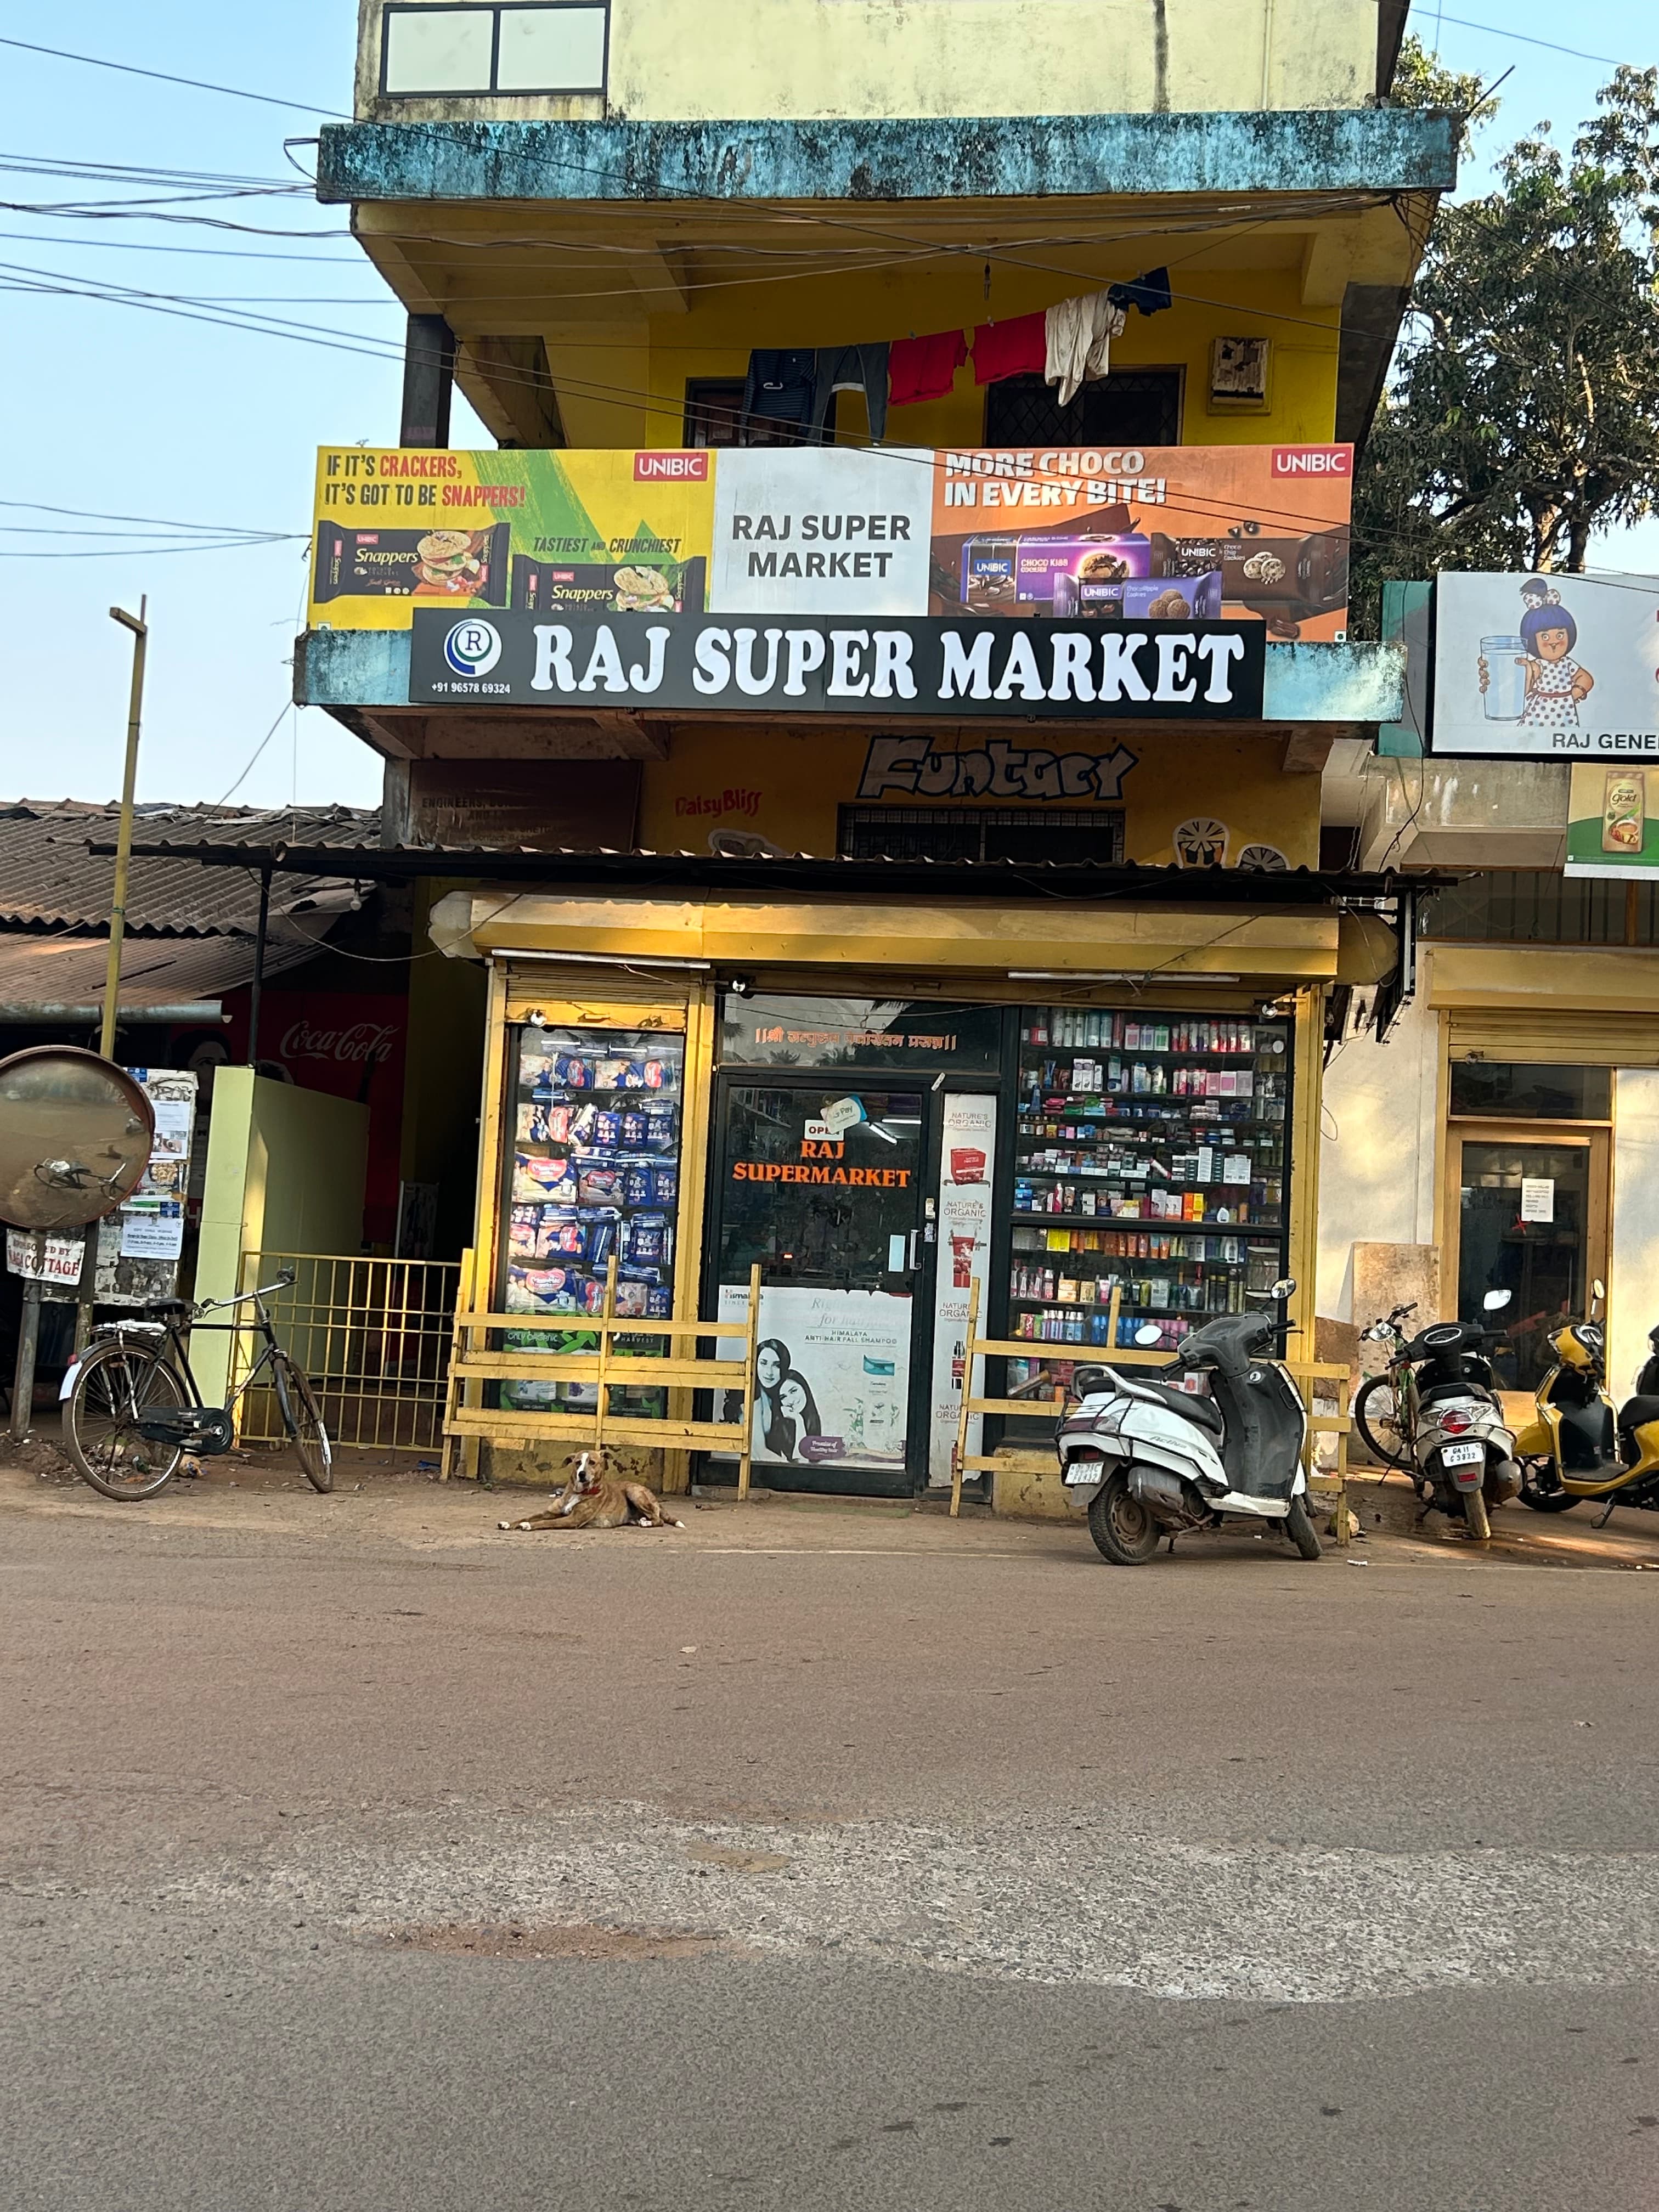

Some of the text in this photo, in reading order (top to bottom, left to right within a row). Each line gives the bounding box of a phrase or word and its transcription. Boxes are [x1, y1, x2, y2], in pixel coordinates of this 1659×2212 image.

[327, 455, 462, 479] IF IT'S CRACKERS,
[639, 458, 702, 476] UNIBIC
[945, 451, 1144, 477] MORE CHOCO
[1277, 453, 1346, 472] UNIBIC
[325, 483, 526, 507] IT'S GOT TO BE SNAPPERS!
[944, 478, 1166, 506] IN EVERY BITE!
[732, 515, 911, 540] RAJ SUPER
[533, 537, 589, 552] TASTIEST
[610, 538, 681, 554] CRUNCHIEST
[1181, 548, 1216, 557] UNIBIC
[355, 548, 419, 566] Snappers
[748, 552, 893, 578] MARKET
[1021, 558, 1049, 567] CHOCO
[977, 562, 1008, 573] UNIBIC
[551, 585, 614, 602] Snappers
[1084, 587, 1119, 597] UNIBIC
[465, 630, 482, 651] R
[531, 625, 1245, 703] RAJ SUPER MARKET
[432, 682, 510, 693] +91 96578 69324
[1553, 733, 1659, 749] RAJ GENE
[800, 1141, 844, 1159] RAJ
[732, 1161, 911, 1187] SUPERMARKET
[944, 1208, 986, 1217] ORGANIC
[59, 1248, 72, 1256] BY
